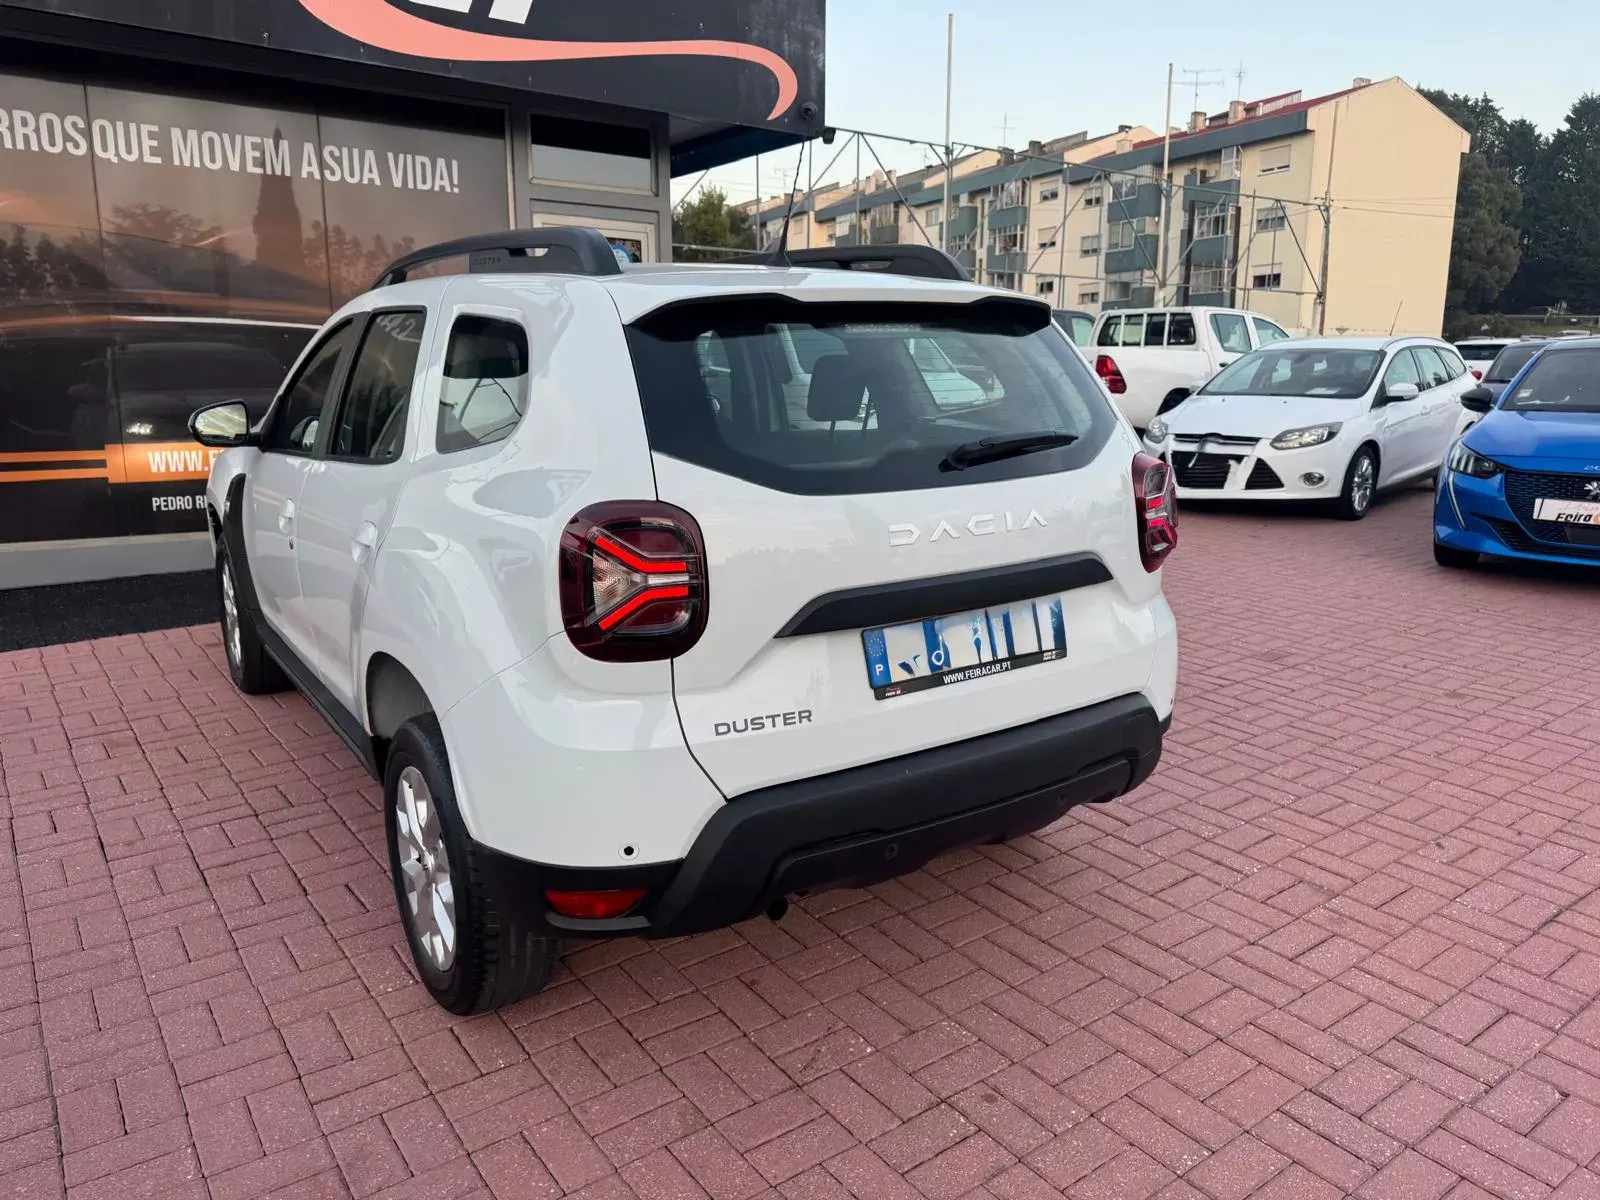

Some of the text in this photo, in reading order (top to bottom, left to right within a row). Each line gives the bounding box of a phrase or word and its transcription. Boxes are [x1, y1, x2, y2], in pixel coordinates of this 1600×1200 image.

[92, 119, 162, 164] QUE
[170, 127, 291, 177] MOVEM
[301, 141, 321, 180] A
[323, 144, 381, 186] SUA
[387, 151, 459, 194] VIDA!
[147, 449, 224, 473] WWW.F
[152, 495, 193, 511] PEDRO
[888, 508, 1048, 547] DACIA
[875, 664, 884, 676] P
[942, 661, 1012, 684] WWW.FEIRACAR.PT
[714, 709, 813, 736] DUSTER
